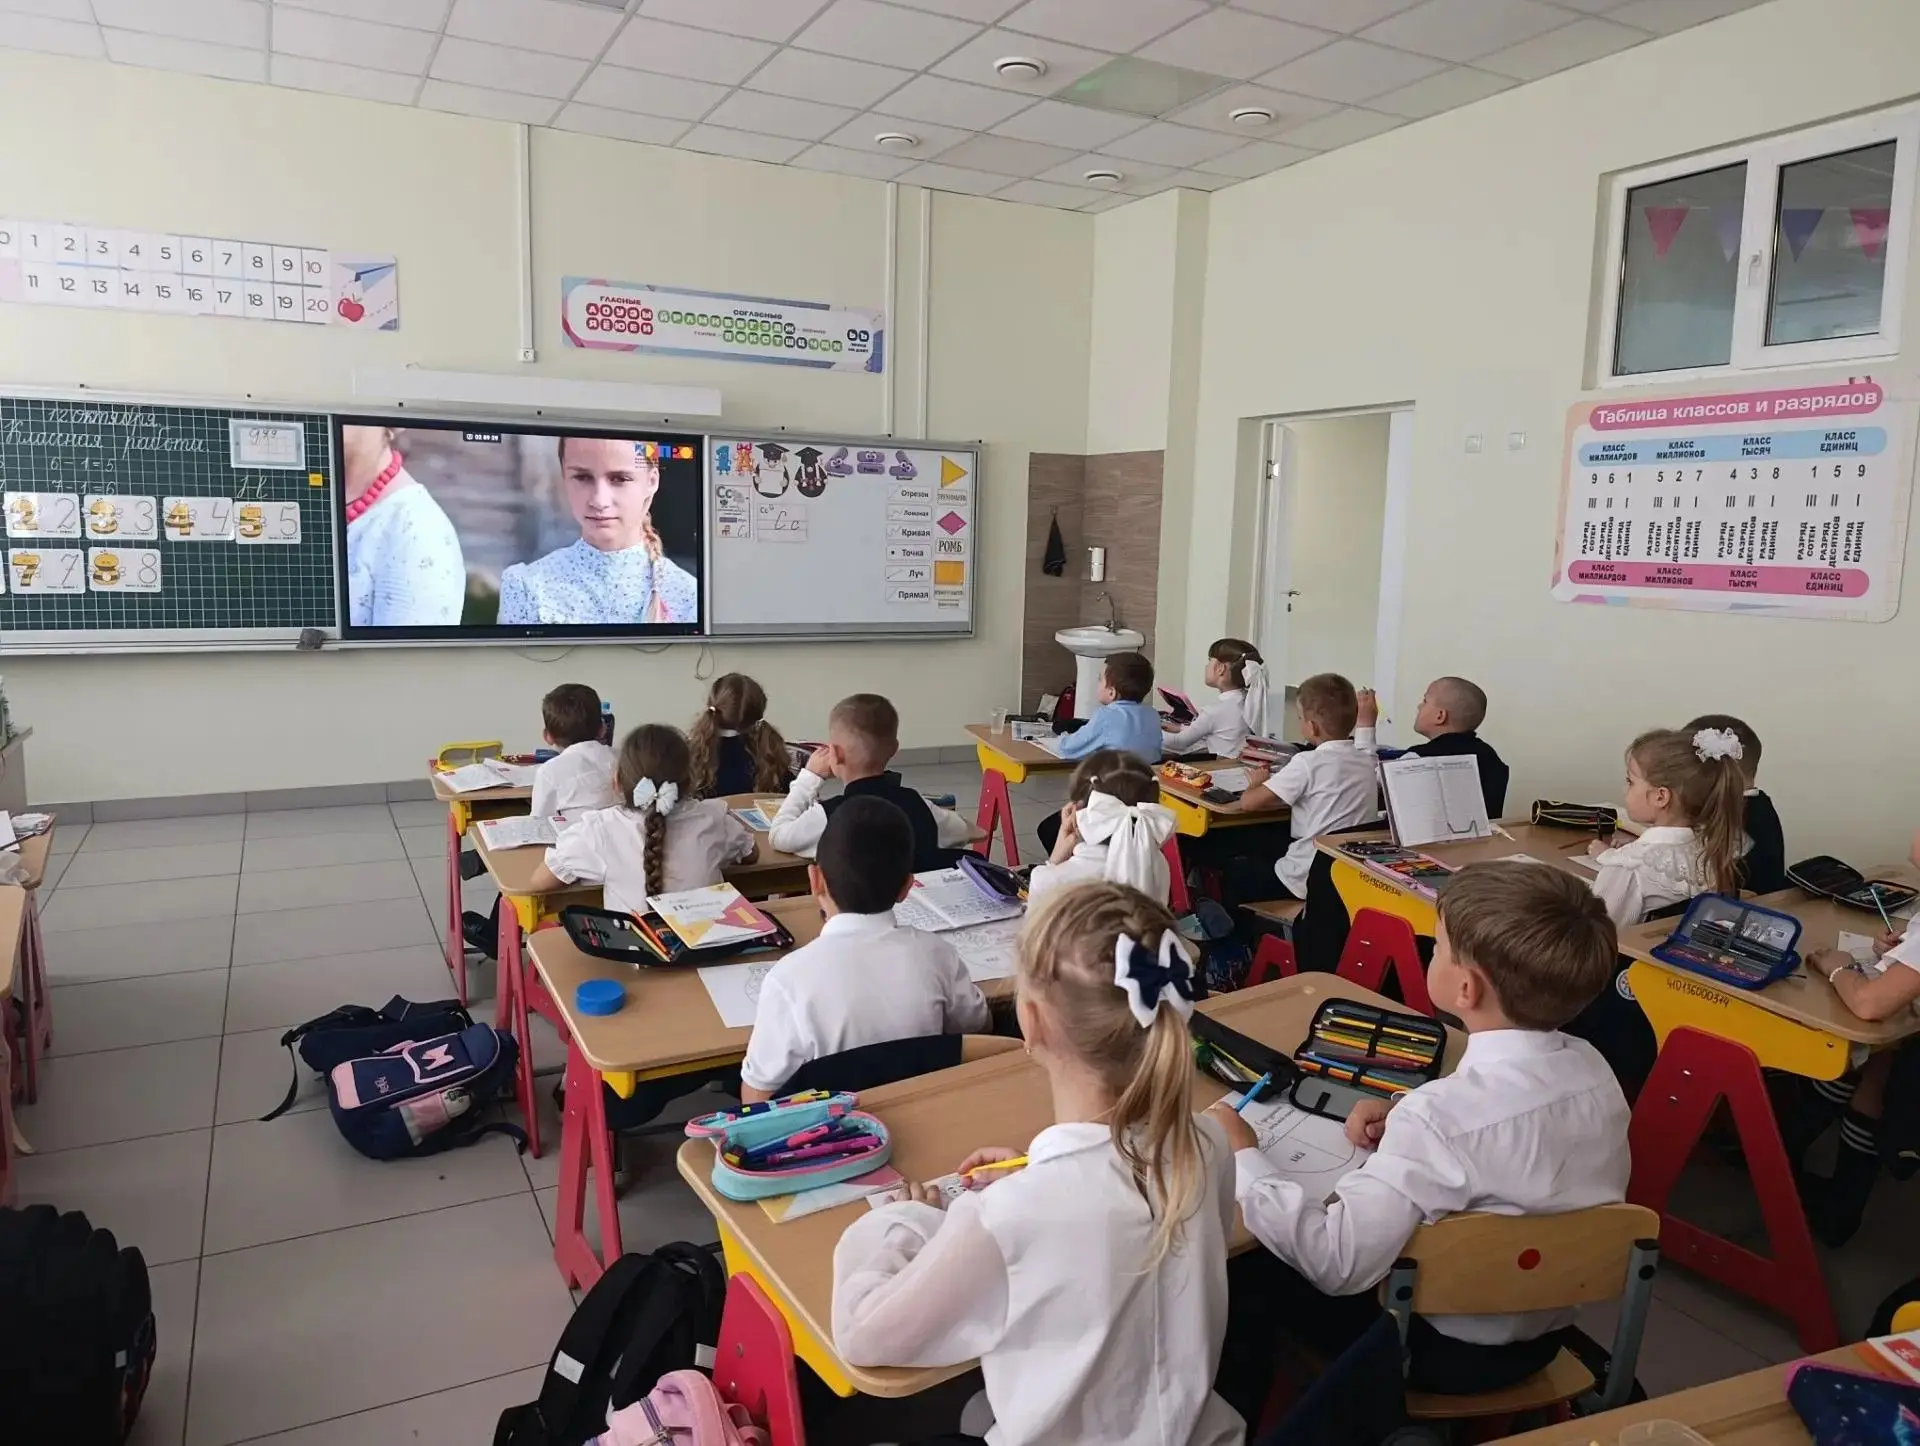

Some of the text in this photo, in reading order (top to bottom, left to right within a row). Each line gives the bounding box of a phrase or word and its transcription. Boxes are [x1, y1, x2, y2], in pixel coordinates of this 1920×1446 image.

[0, 231, 322, 274] 0 1 2 3 4 5 6 7 8 9 10
[28, 274, 329, 312] 11 12 13 14 15 16 17 18 19 20
[600, 296, 641, 305] ГЛАСНЫЕ
[1597, 392, 1877, 424] Таблица классов и разрядов
[1602, 444, 1625, 452] КЛАСС
[1668, 441, 1694, 449] КЛАСС
[1741, 447, 1771, 456] ТЫСЯЧ
[1743, 437, 1771, 446] КЛАСС
[1820, 442, 1858, 452] ЕДИНИЦ
[1825, 432, 1856, 441] КЛАСС
[1589, 452, 1638, 461] МИЛЛИАРДОВ
[1656, 450, 1705, 459] МИЛЛИОНОВ
[1591, 464, 1866, 484] 9 6 1 5 2 7 4 3 8 1 5 9
[56, 498, 76, 529] 2
[135, 500, 154, 531] 3
[212, 502, 230, 532] 4
[280, 506, 298, 536] 5
[901, 529, 931, 537] Кривая
[938, 540, 962, 553] РОМБ
[1582, 521, 1590, 554] РАЗРЯД
[1599, 521, 1607, 555] РАЗРЯД
[1605, 516, 1614, 560] ДЕСЯТКОВ
[1616, 521, 1624, 555] РАЗРЯД
[1623, 520, 1632, 556] ЕДИНИЦ
[1646, 521, 1655, 556] РАЗРЯД
[1654, 525, 1662, 553] СОТЕН
[1665, 521, 1674, 556] РАЗРЯД
[1672, 516, 1682, 562] ДЕСЯТКОВ
[1684, 521, 1693, 557] РАЗРЯД
[1692, 520, 1701, 558] ЕДИНИЦ
[1718, 521, 1727, 558] РАЗРЯД
[1726, 525, 1735, 555] СОТЕН
[1738, 521, 1748, 558] РАЗРЯД
[1746, 516, 1757, 565] ДЕСЯТКОВ
[1759, 522, 1769, 559] РАЗРЯД
[1768, 520, 1778, 560] ЕДИНИЦ
[1797, 522, 1808, 560] РАЗРЯД
[1807, 525, 1816, 557] СОТЕН
[1820, 522, 1831, 560] РАЗРЯД
[1829, 516, 1840, 568] ДЕСЯТКОВ
[1843, 522, 1854, 561] РАЗРЯД
[1853, 521, 1864, 562] ЕДИНИЦ
[139, 553, 157, 584] 8
[902, 549, 924, 557] Точка
[1591, 564, 1614, 572] КЛАСС
[61, 553, 79, 585] 7
[909, 569, 924, 579] Луч
[1578, 572, 1627, 581] МИЛЛИАРДОВ
[1645, 576, 1693, 585] МИЛЛИОНОВ
[1657, 567, 1682, 575] КЛАСС
[1728, 580, 1757, 588] ТЫСЯЧ
[1730, 570, 1757, 578] КЛАСС
[1810, 572, 1841, 580] КЛАСС
[898, 591, 929, 600] Прямая
[1805, 582, 1843, 592] ЕДИНИЦ
